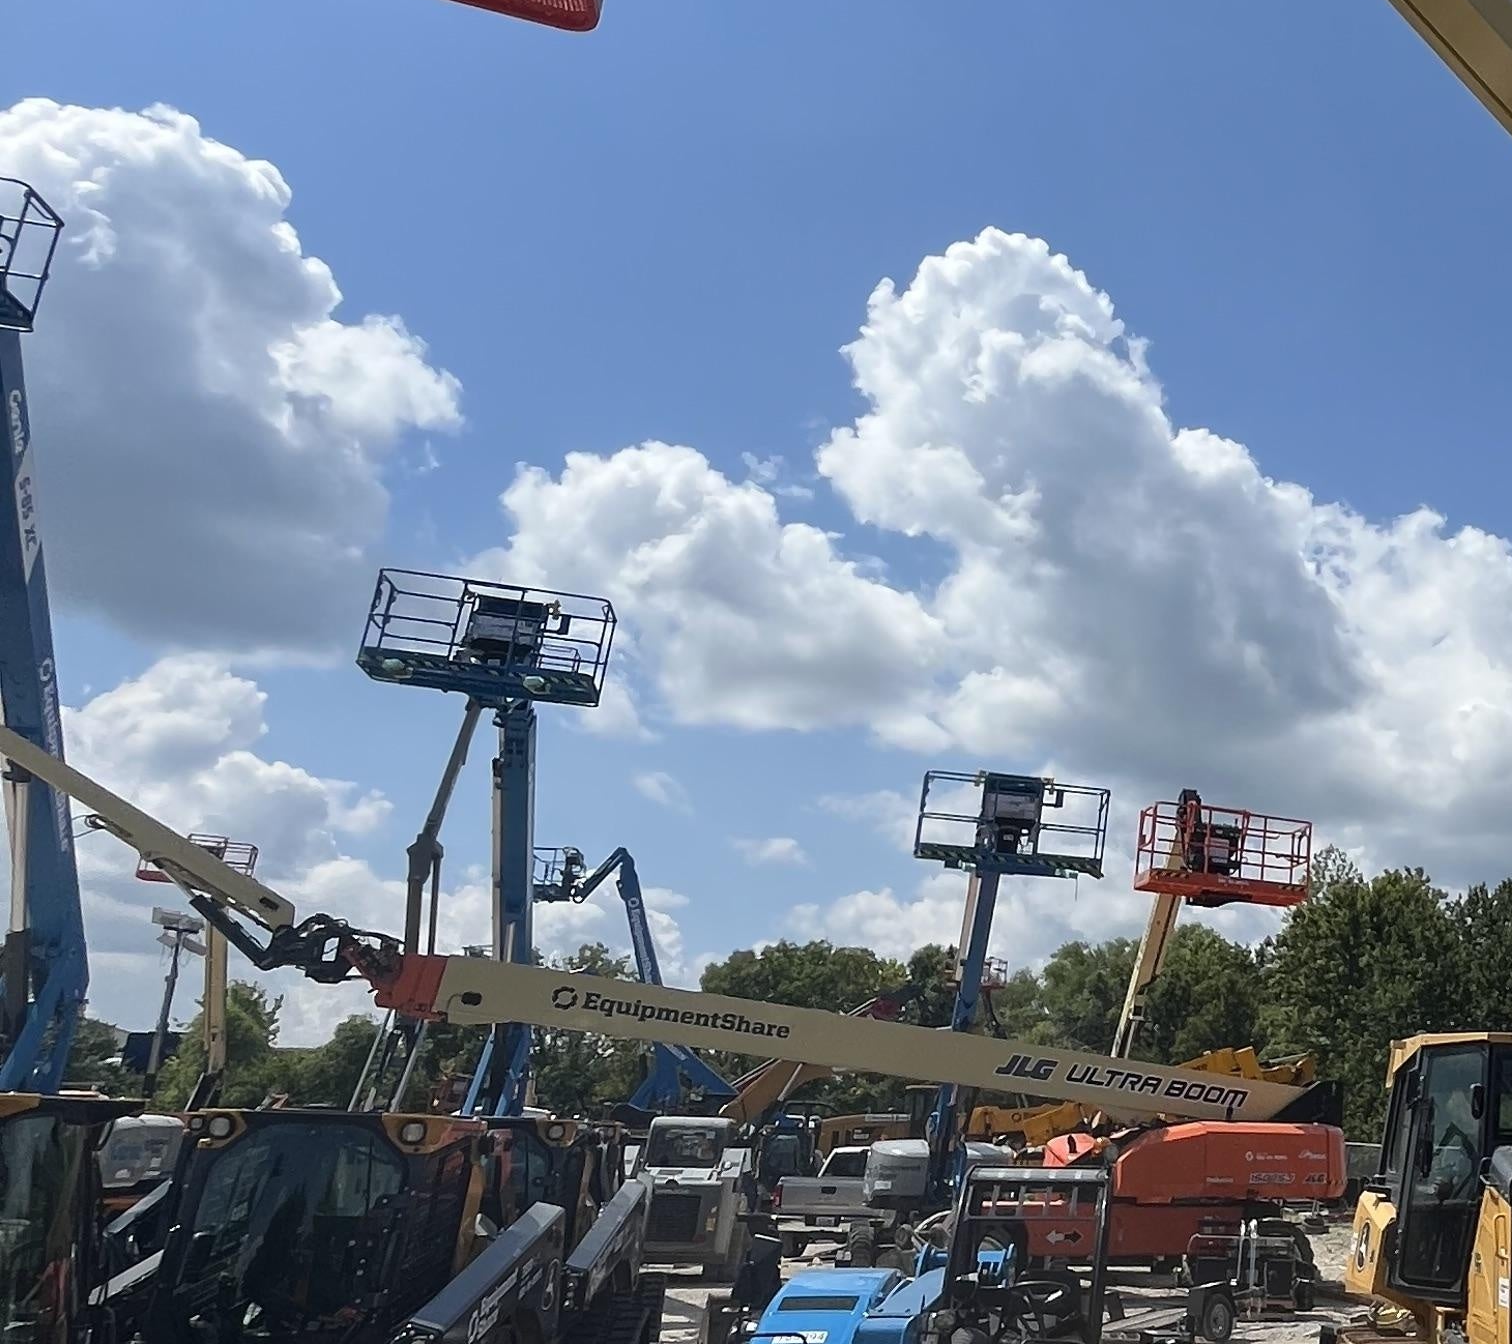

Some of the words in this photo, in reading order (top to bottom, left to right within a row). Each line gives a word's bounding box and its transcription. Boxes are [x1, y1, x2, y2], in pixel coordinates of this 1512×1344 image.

[581, 992, 790, 1039] EquipmentShare
[995, 1054, 1058, 1081] JLG
[1065, 1063, 1163, 1094] ULTRA
[1163, 1079, 1249, 1108] BOOM
